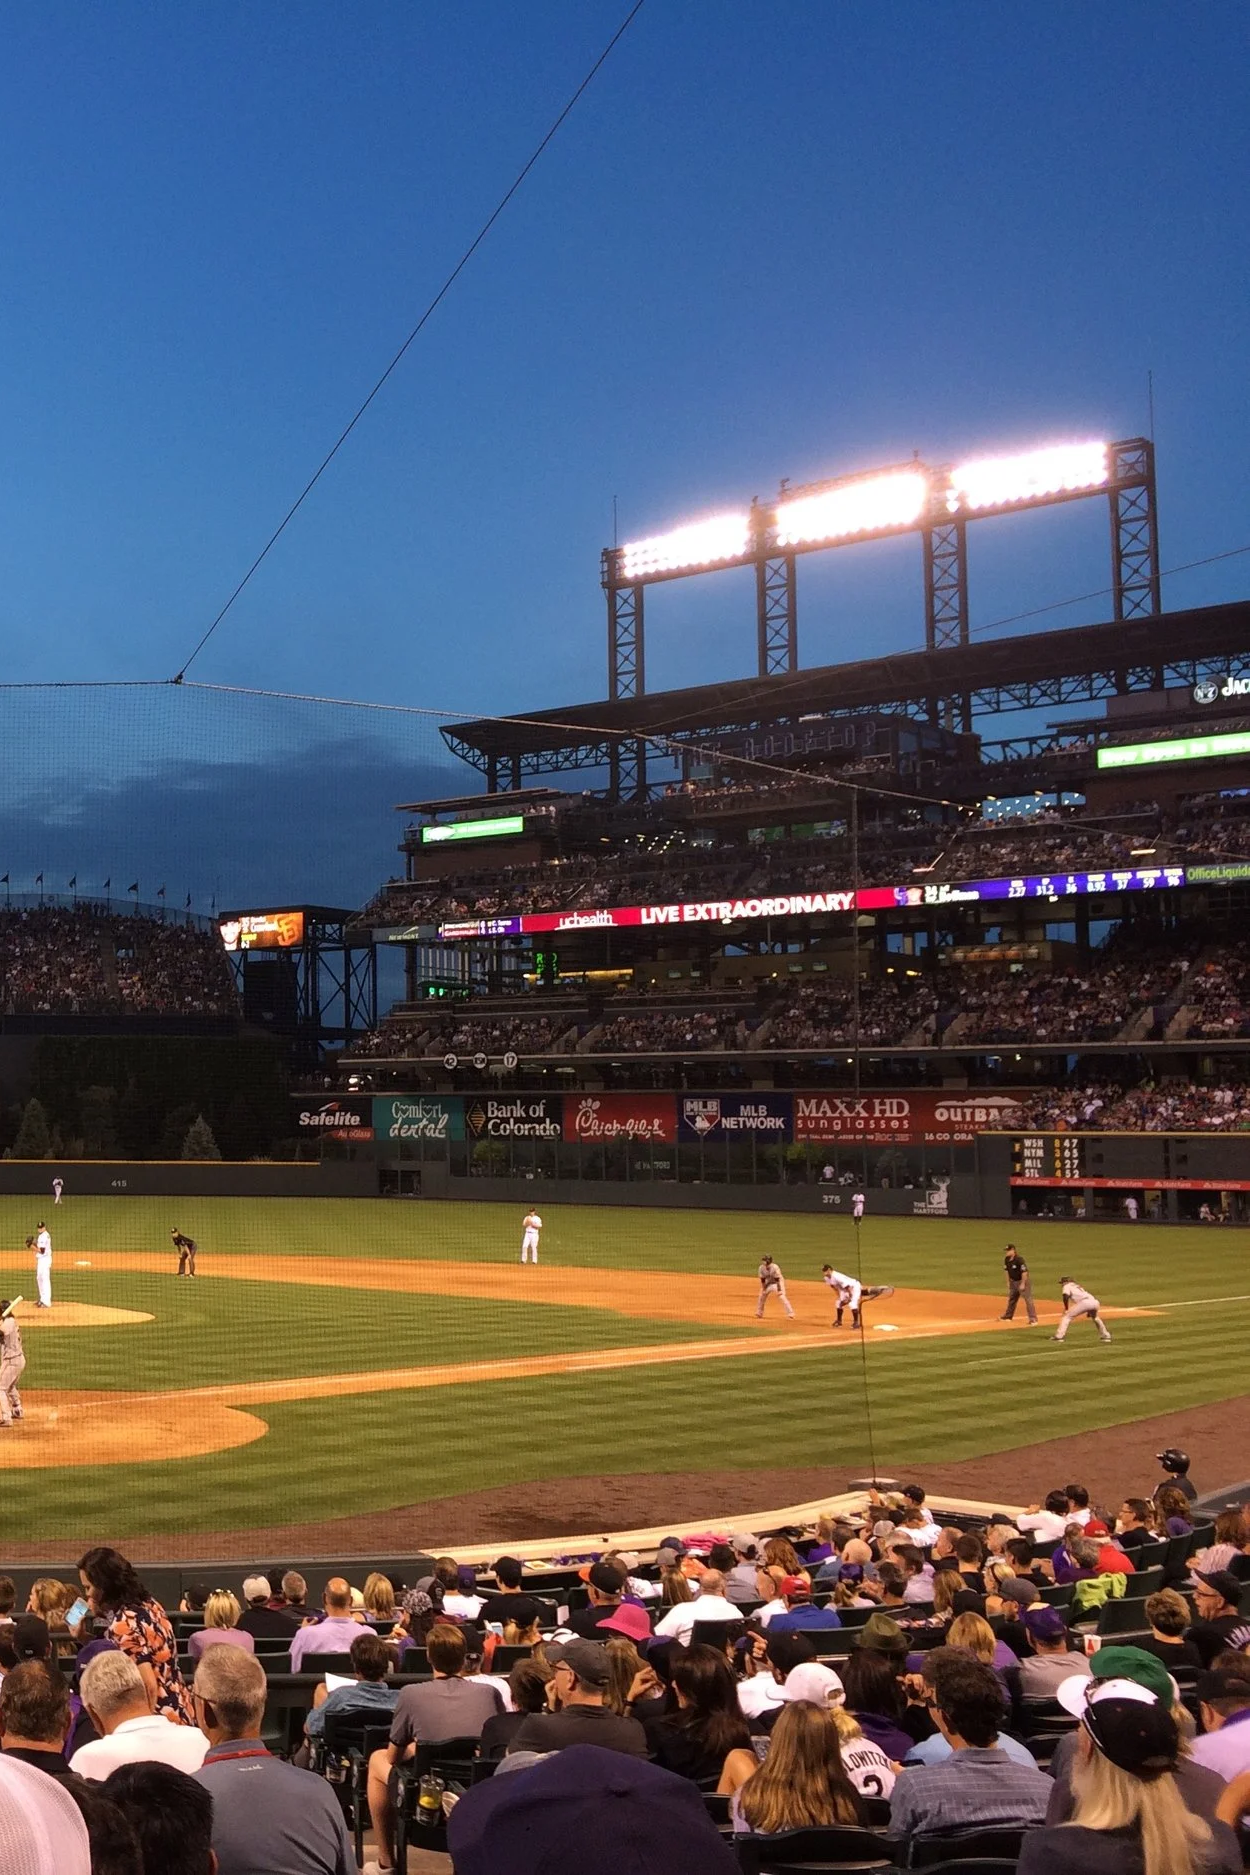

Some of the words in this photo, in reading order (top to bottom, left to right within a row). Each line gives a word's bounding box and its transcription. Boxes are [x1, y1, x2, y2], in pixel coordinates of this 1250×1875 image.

[1117, 880, 1128, 890] 37
[1143, 878, 1155, 888] 59
[1036, 885, 1054, 896] 31.2
[559, 910, 613, 928] uchealth
[641, 904, 683, 925] LIVE
[684, 892, 855, 921] EXTRAORDINARY.
[506, 1056, 516, 1065] 17
[392, 1098, 442, 1118] Comfort
[488, 1100, 526, 1118] Bank
[529, 1100, 546, 1118] of
[686, 1101, 718, 1112] MLB
[740, 1105, 768, 1116] MLB
[796, 1098, 868, 1117] MAXX
[872, 1098, 910, 1118] HD
[299, 1112, 361, 1126] Safelite
[934, 1108, 1001, 1122] OUTBA
[390, 1113, 448, 1138] dental
[488, 1118, 560, 1136] Colorado
[721, 1117, 785, 1130] NETWORK
[797, 1118, 910, 1131] sunglasses
[338, 1130, 370, 1138] AuoGlass
[875, 1132, 910, 1142] ROCIES
[924, 1132, 934, 1140] 16
[1014, 1143, 1021, 1152] F
[1024, 1138, 1044, 1148] WSH
[1054, 1138, 1060, 1148] 8
[1024, 1148, 1044, 1158] NYM
[1054, 1148, 1060, 1158] 3
[1015, 1163, 1022, 1172] F
[1024, 1159, 1042, 1168] MIL
[1054, 1160, 1062, 1168] 6
[1024, 1169, 1040, 1178] STL
[1055, 1170, 1062, 1178] 4
